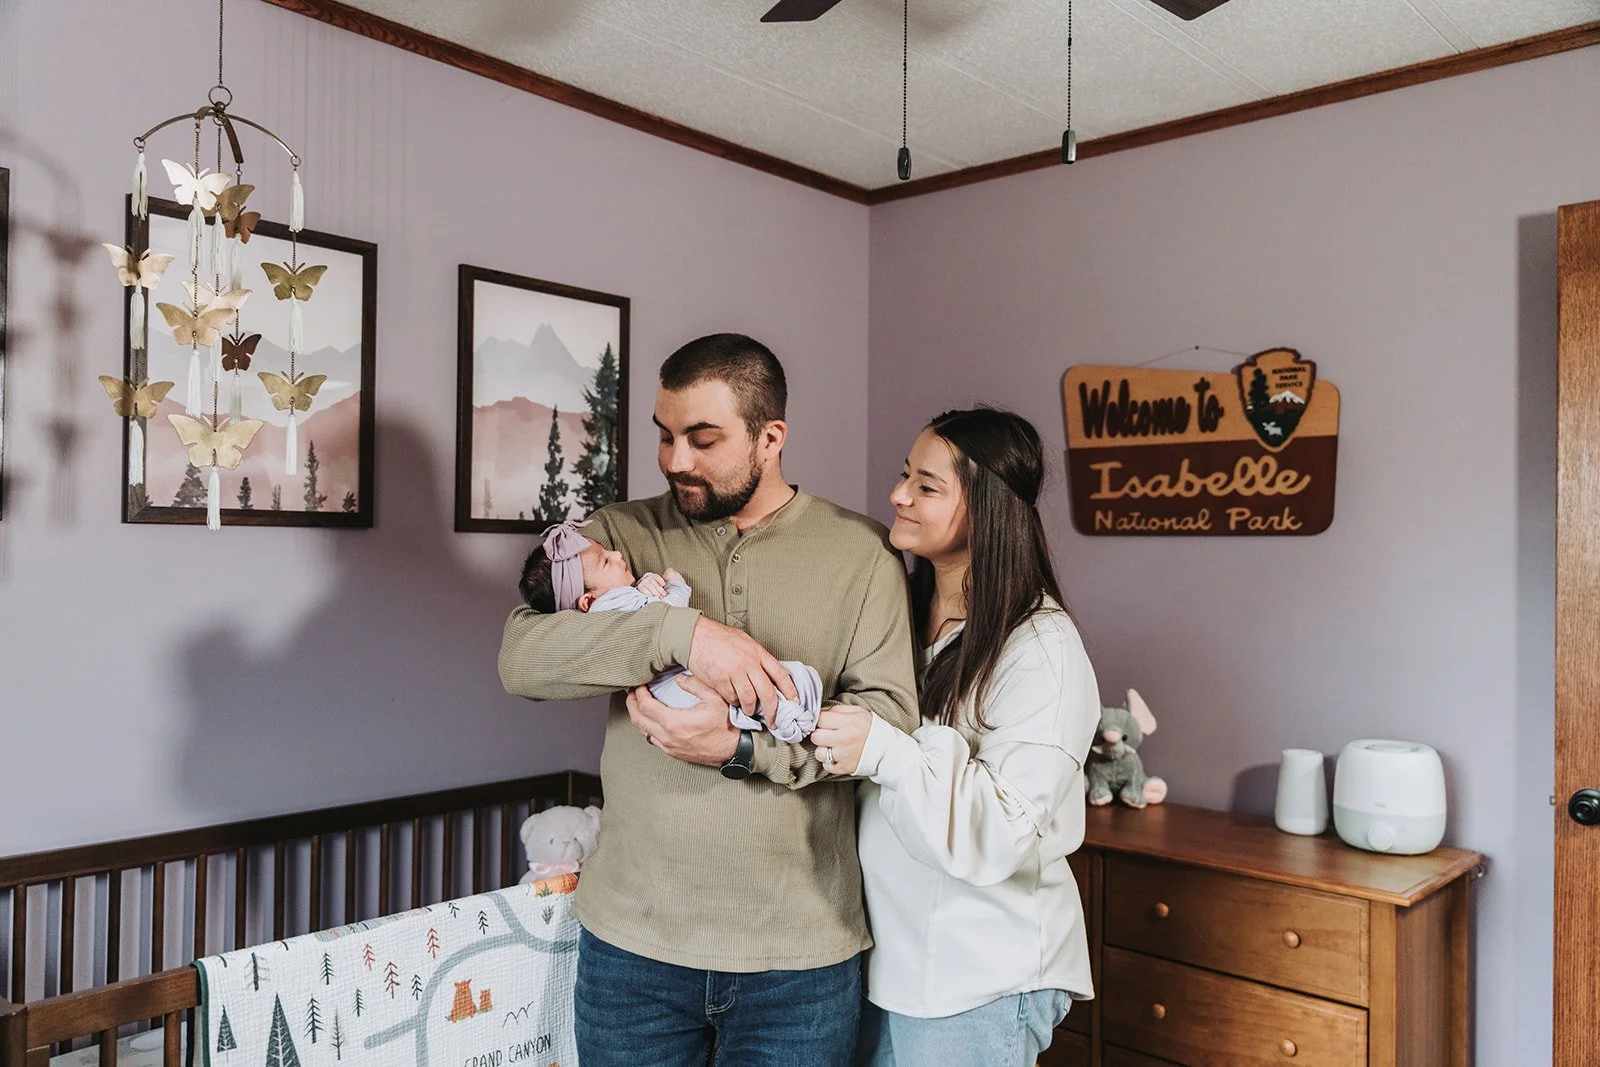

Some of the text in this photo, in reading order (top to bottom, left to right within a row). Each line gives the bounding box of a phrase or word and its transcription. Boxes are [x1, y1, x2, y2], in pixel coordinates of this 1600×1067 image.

[1079, 377, 1225, 439] Welcome to
[1089, 456, 1311, 500] Isabelle
[1095, 507, 1303, 531] National Park
[508, 1033, 551, 1063] CANYON
